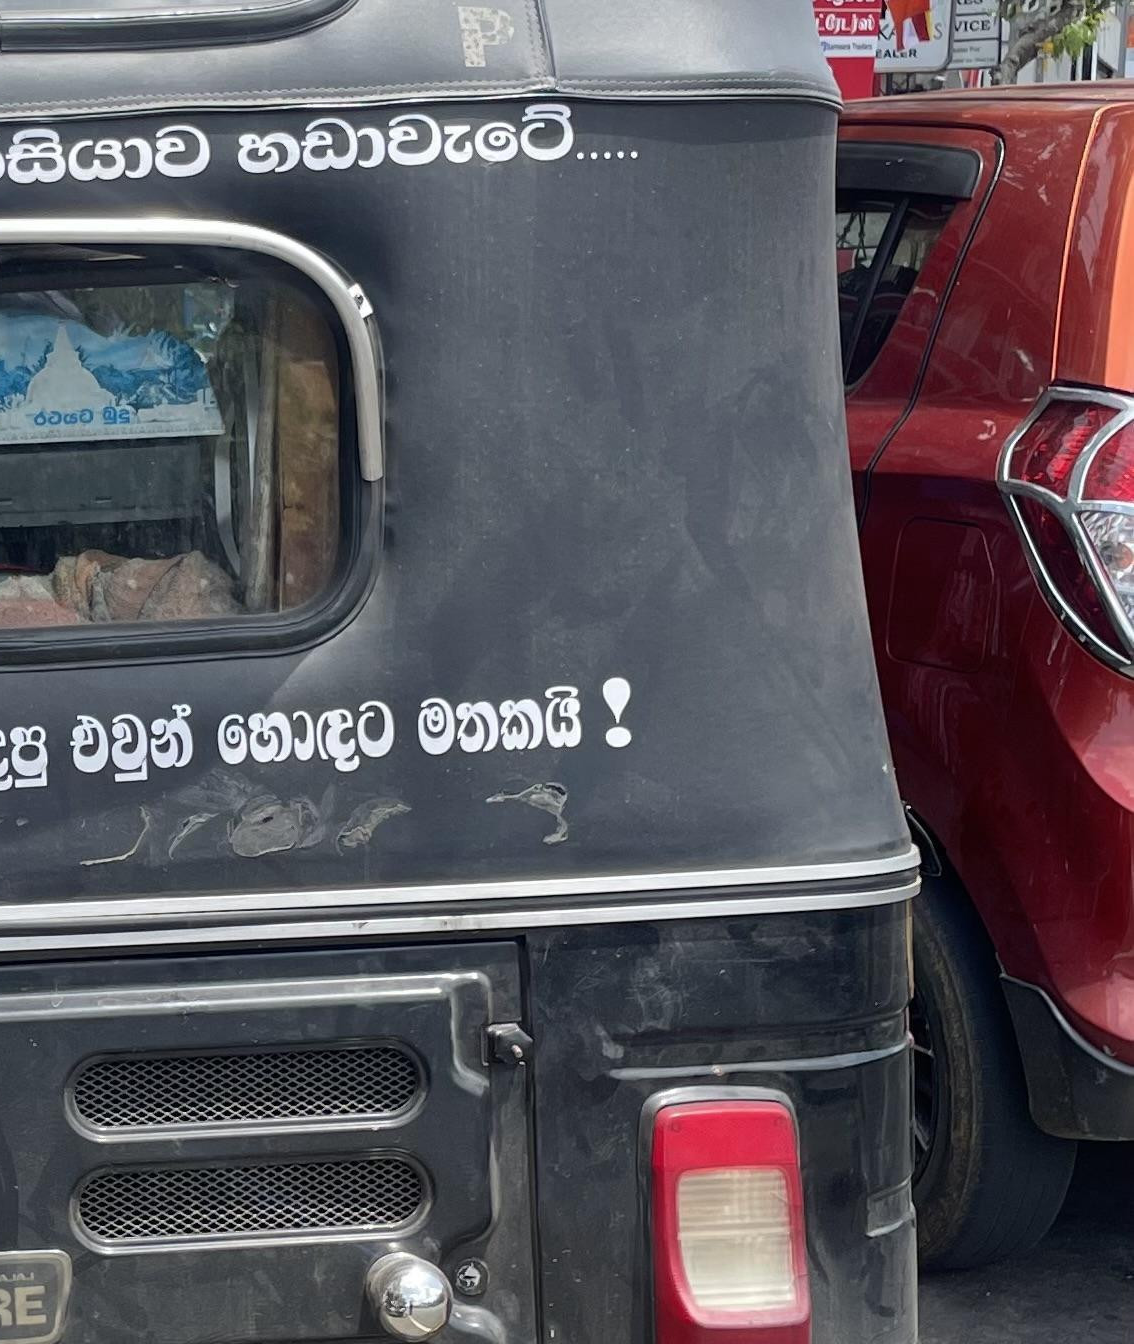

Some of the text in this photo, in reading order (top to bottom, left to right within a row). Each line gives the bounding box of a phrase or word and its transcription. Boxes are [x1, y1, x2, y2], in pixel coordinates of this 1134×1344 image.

[954, 20, 991, 33] VICE
[875, 48, 918, 59] EALER
[69, 703, 194, 783] එවුන්
[217, 700, 396, 773] හොඳට
[418, 685, 583, 755] මතකයි
